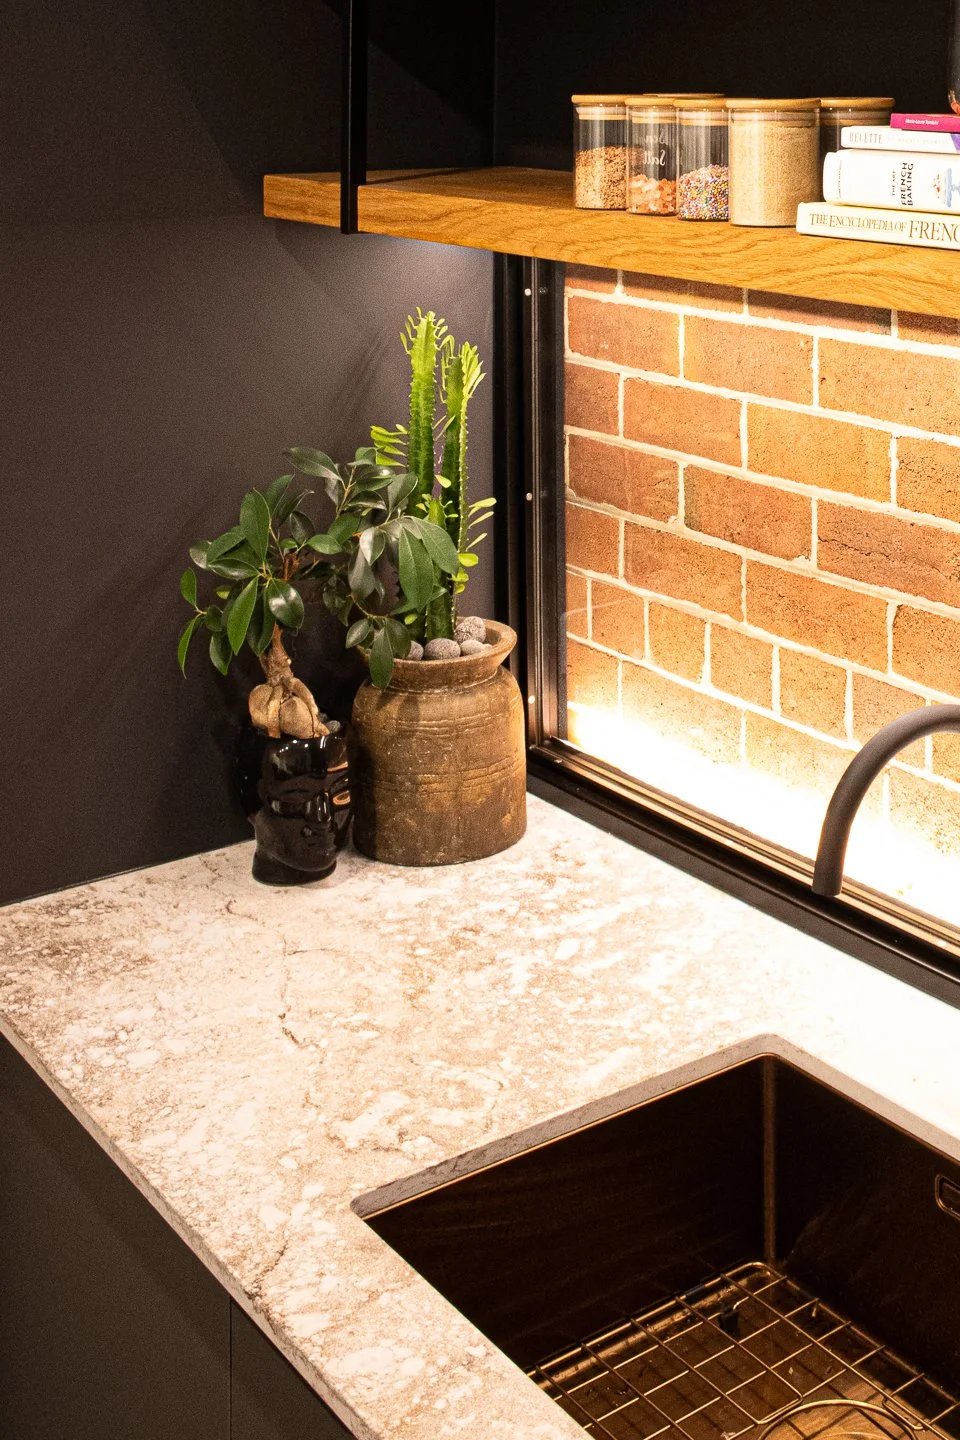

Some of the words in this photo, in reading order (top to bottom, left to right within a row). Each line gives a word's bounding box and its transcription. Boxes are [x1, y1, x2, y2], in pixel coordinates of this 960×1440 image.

[900, 162, 908, 207] FRENCH
[906, 163, 914, 207] BAKING
[809, 212, 828, 227] THE
[829, 215, 894, 232] ENCYCLOPEDIA
[894, 221, 908, 232] OF
